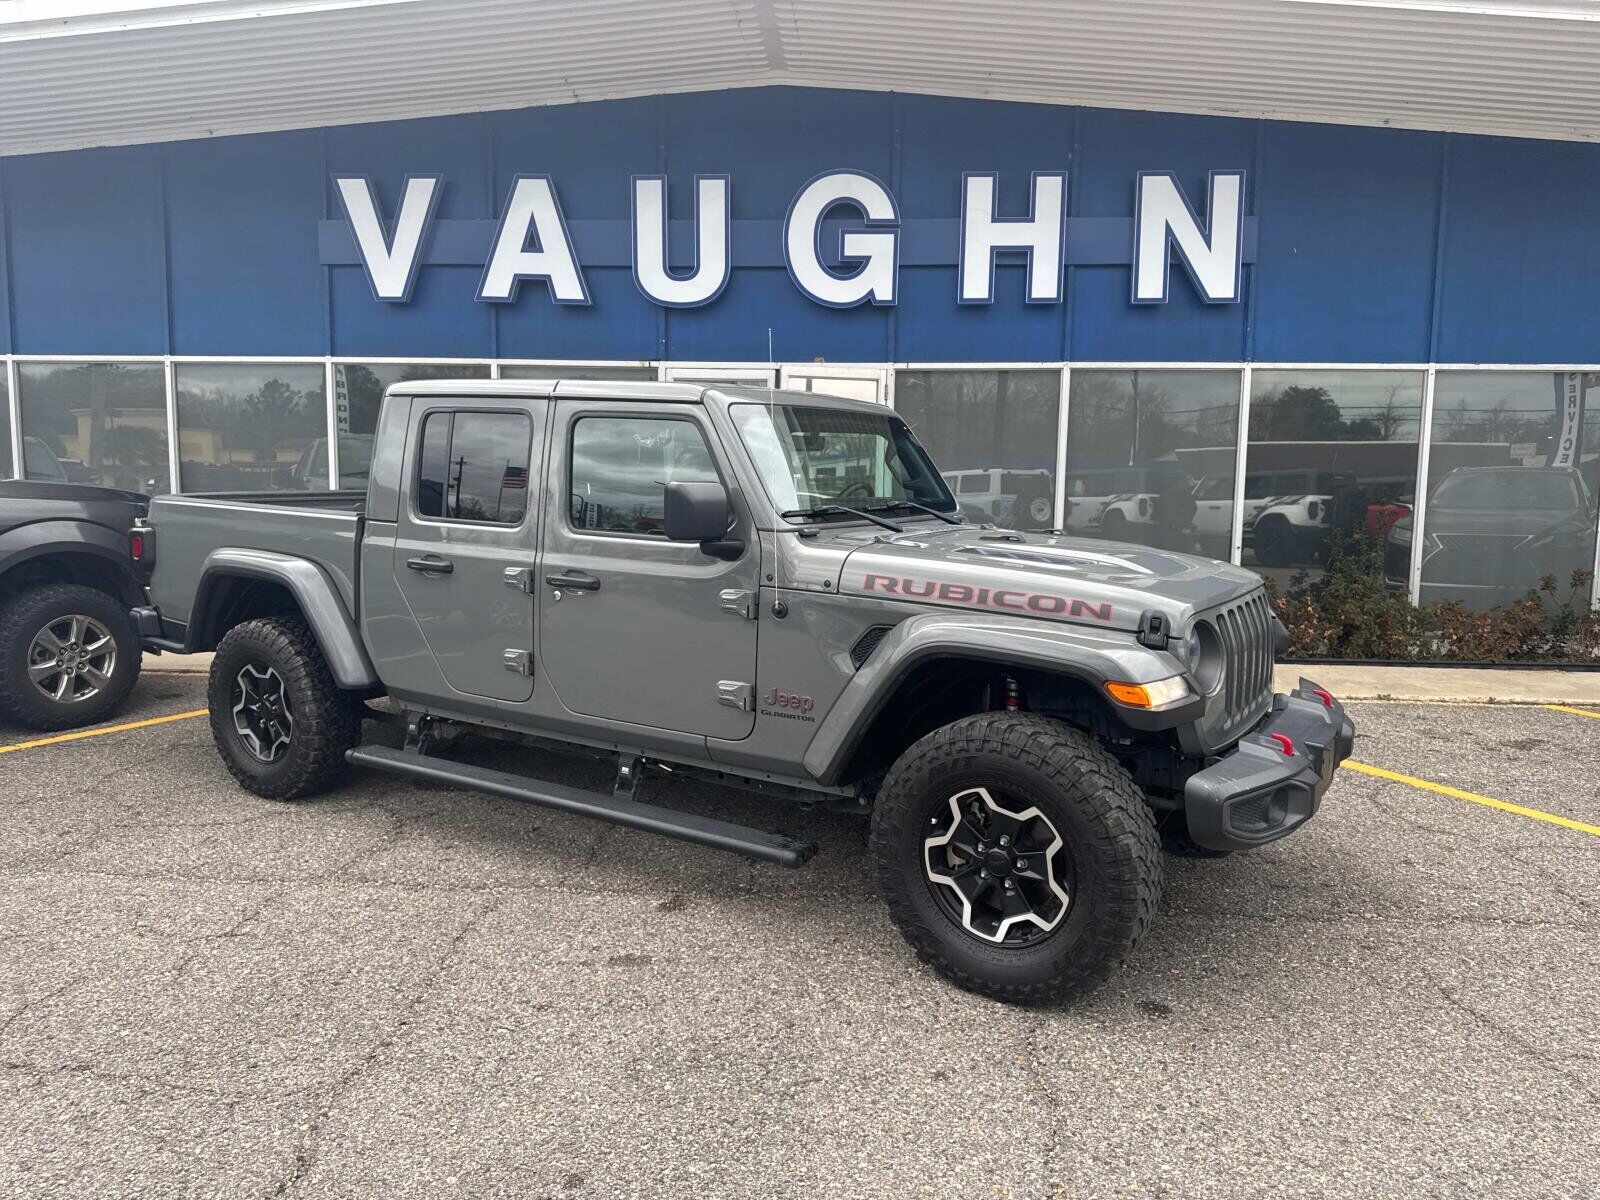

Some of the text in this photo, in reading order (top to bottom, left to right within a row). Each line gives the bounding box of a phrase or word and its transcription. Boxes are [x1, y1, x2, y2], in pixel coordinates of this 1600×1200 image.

[332, 169, 1244, 305] VAUGHN
[863, 573, 1113, 621] RUBICON
[761, 709, 815, 722] GLADIATOR
[764, 687, 815, 714] Jeep
